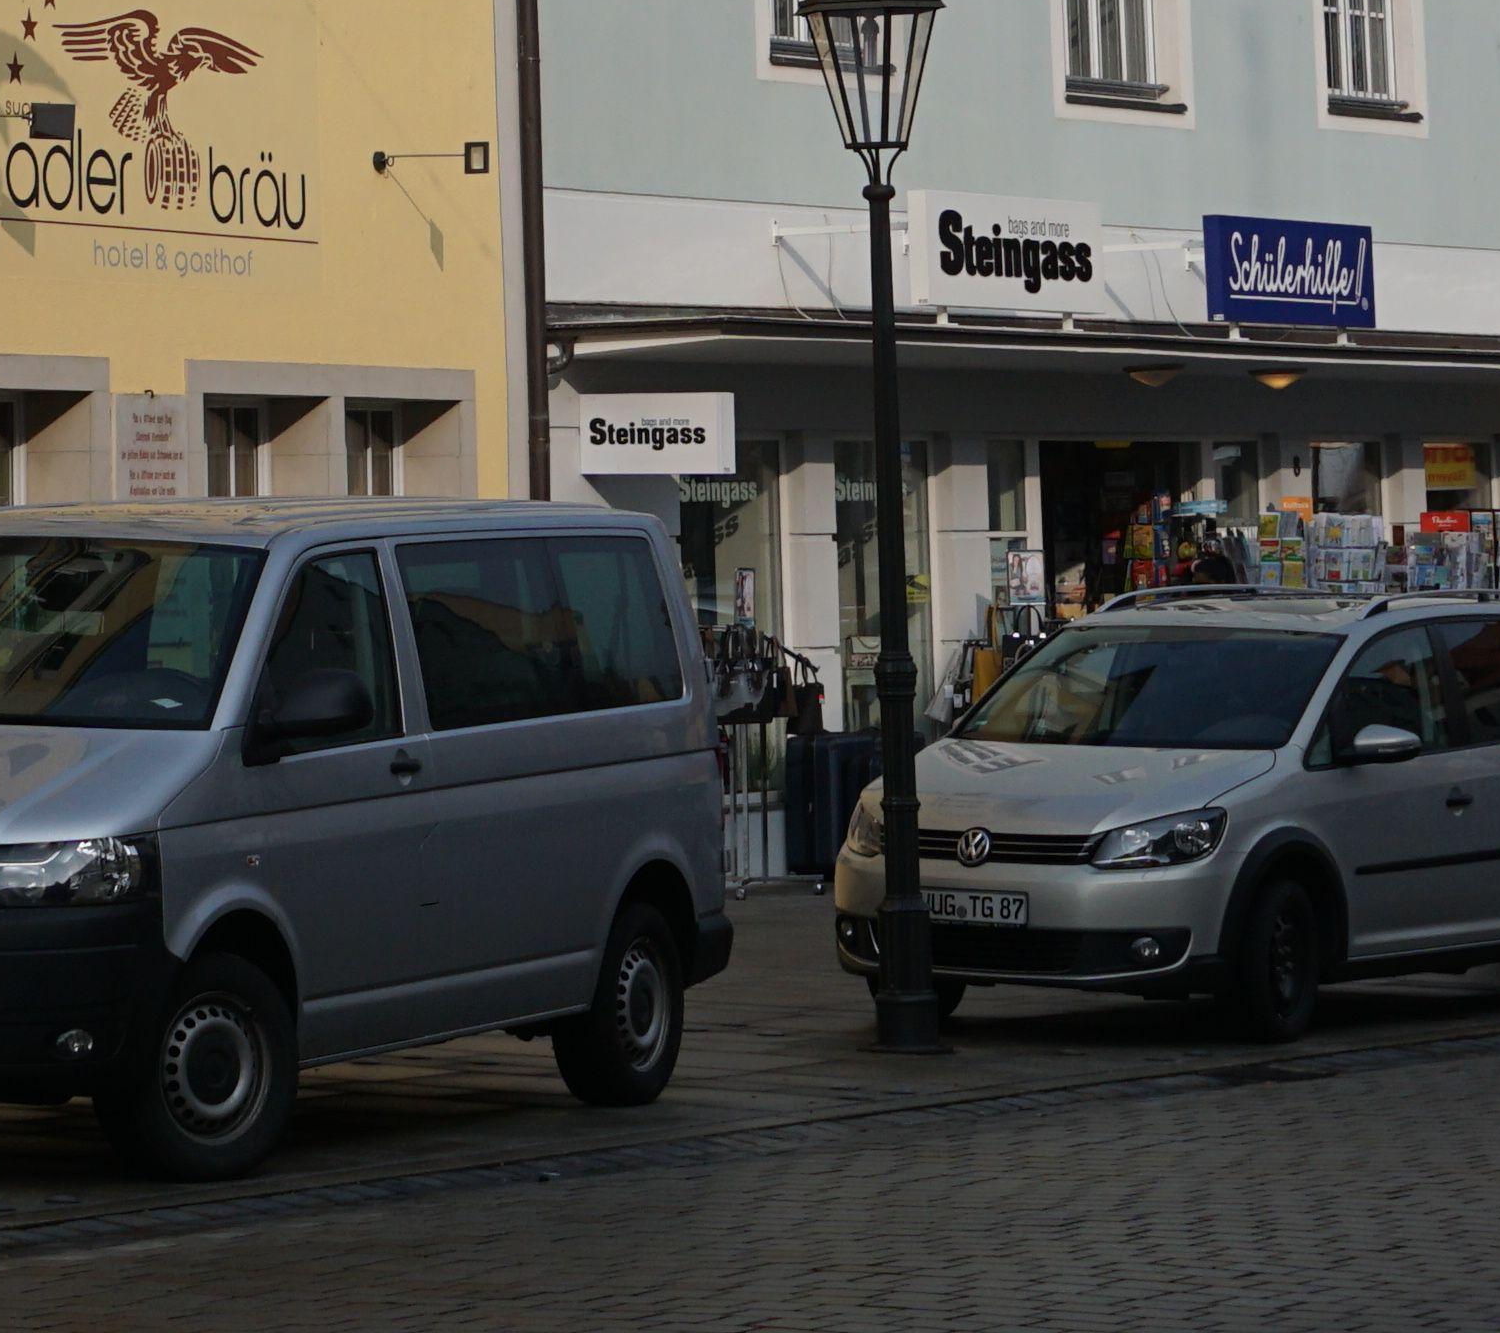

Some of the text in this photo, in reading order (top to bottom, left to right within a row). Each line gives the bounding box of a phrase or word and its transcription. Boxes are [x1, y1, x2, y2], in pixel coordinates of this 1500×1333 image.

[5, 129, 306, 231] adler bräu
[1007, 216, 1071, 238] bags and more
[93, 238, 254, 278] hotel & gasthof
[938, 209, 1093, 294] Steingass
[589, 417, 706, 451] Steingass
[641, 417, 690, 429] bags and more
[679, 477, 758, 509] Steingass
[927, 893, 1024, 920] UG TG 87
